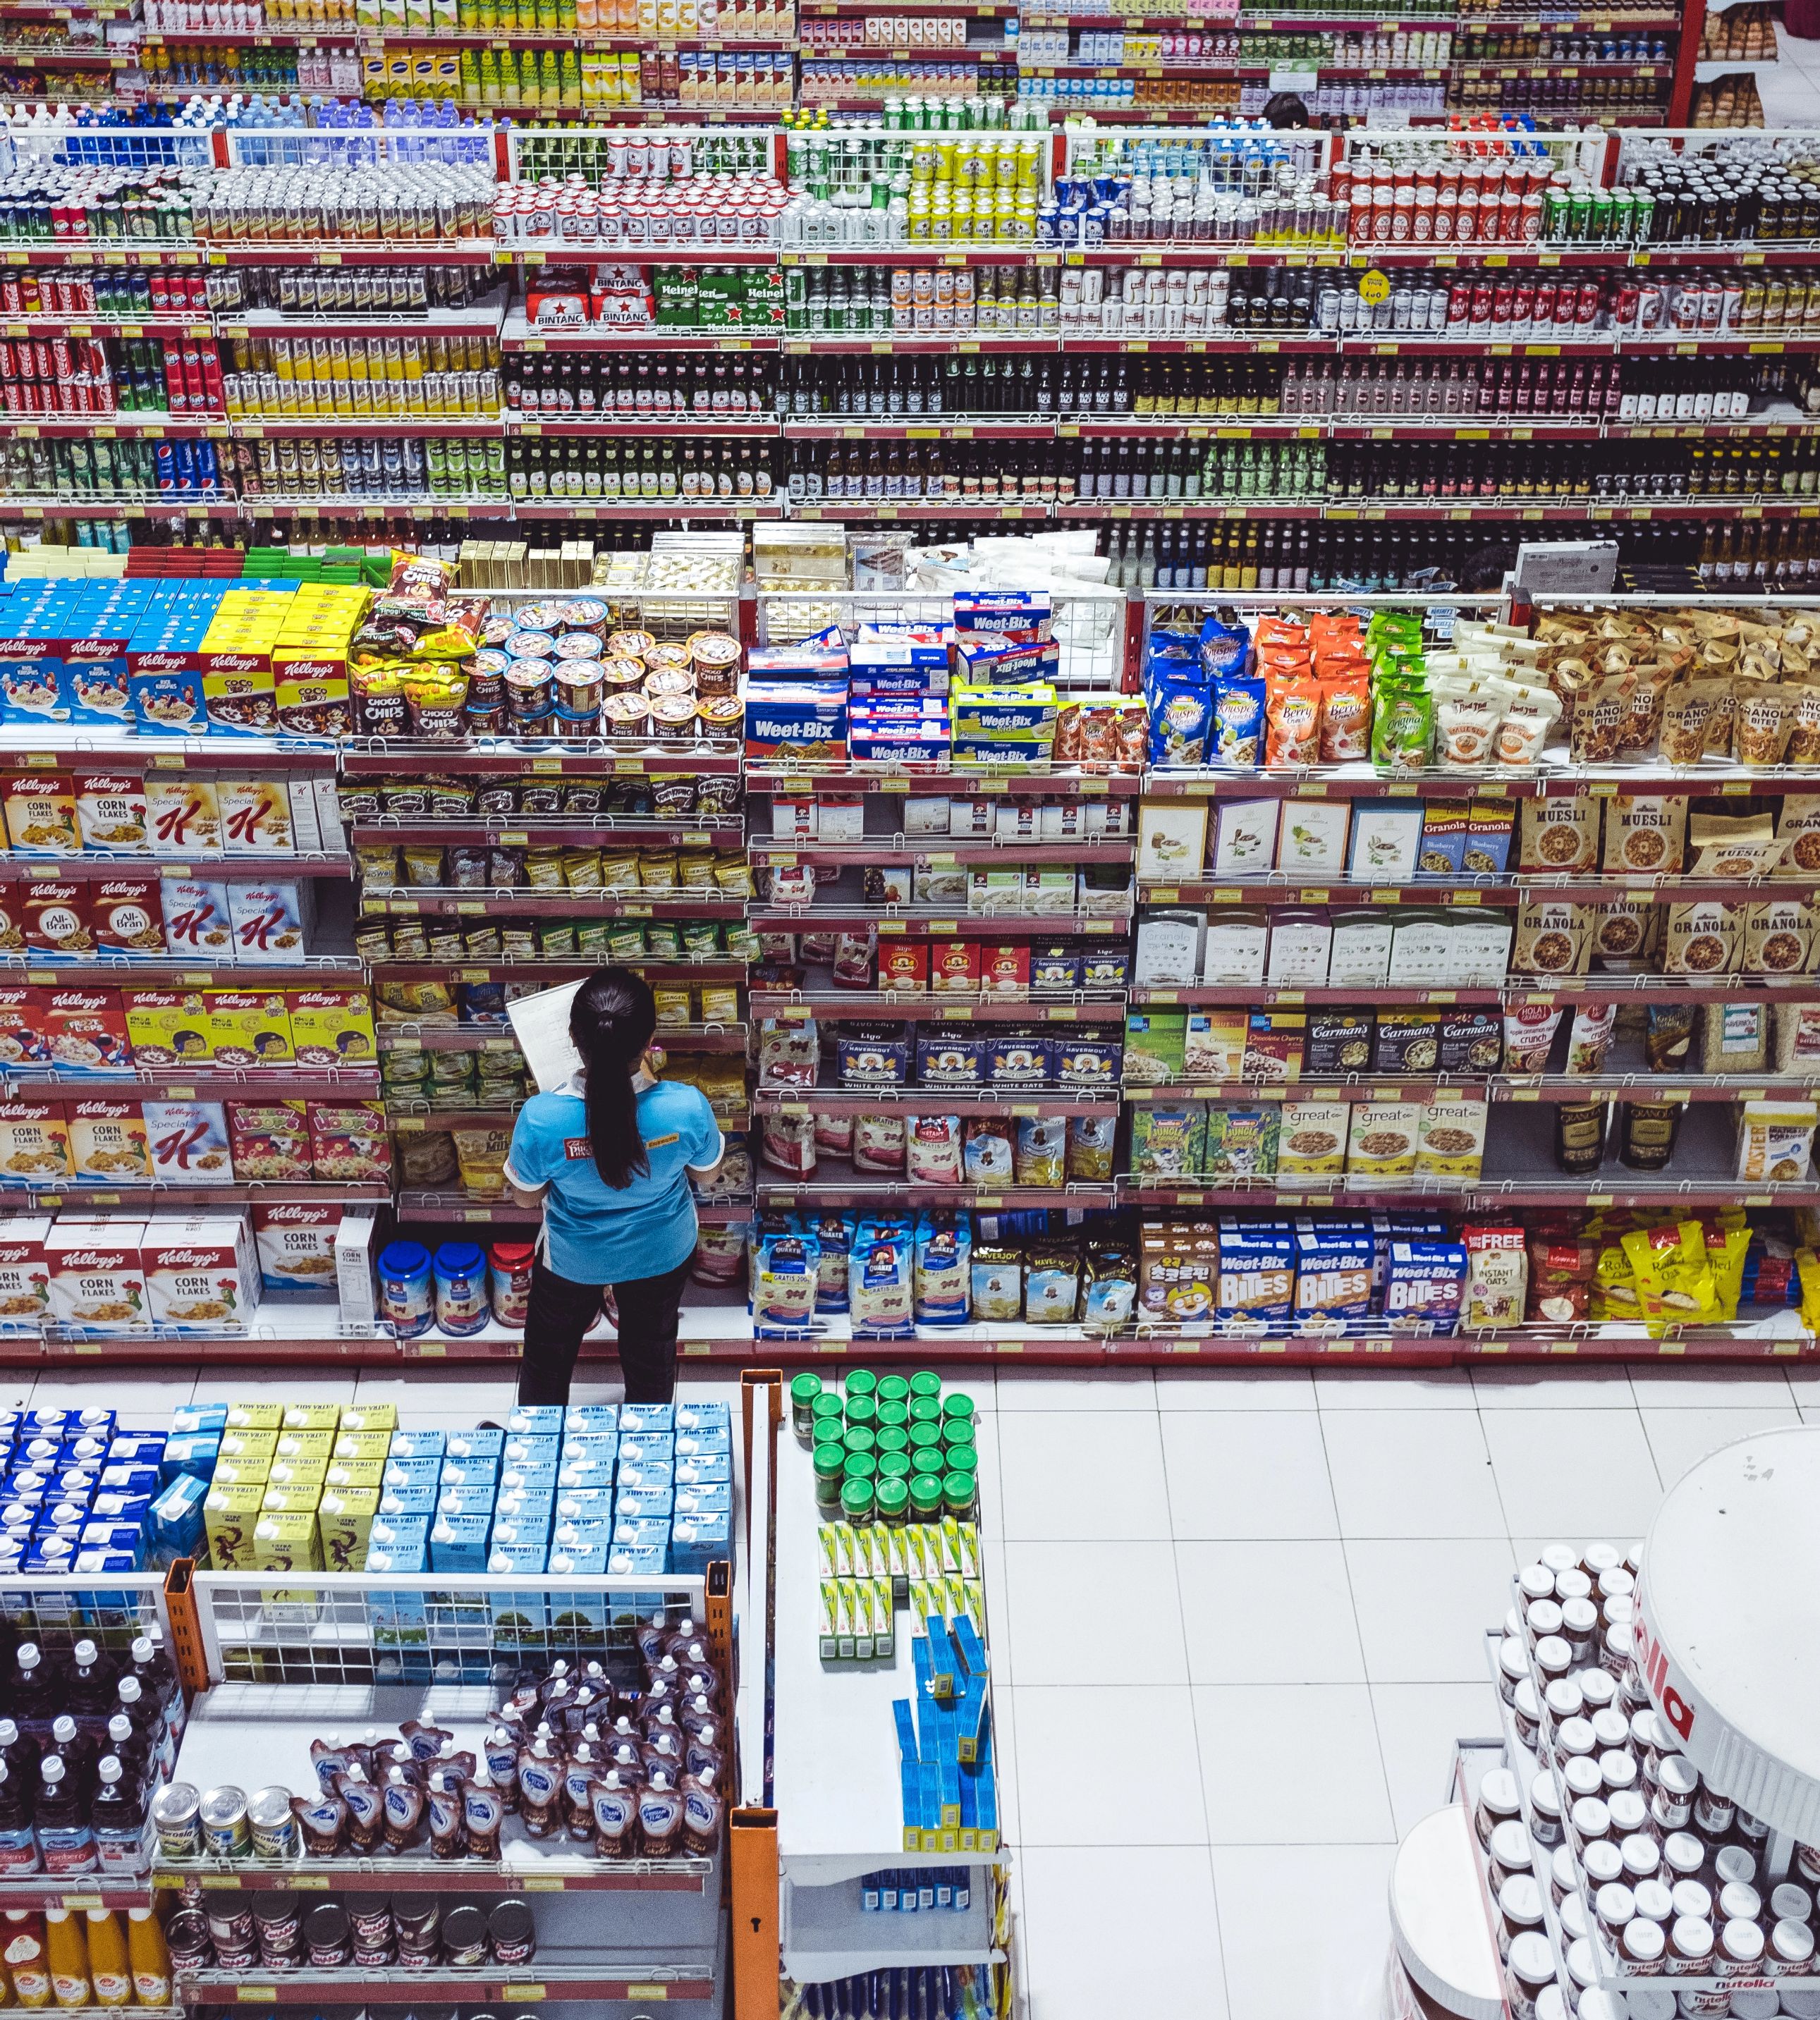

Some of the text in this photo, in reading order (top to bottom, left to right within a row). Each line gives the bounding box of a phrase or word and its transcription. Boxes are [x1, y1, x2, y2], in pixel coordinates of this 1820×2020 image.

[598, 279, 642, 288] BINTANG
[662, 285, 698, 295] Heine
[538, 315, 582, 324] BINTANG
[604, 312, 647, 321] BINTANG
[407, 565, 441, 575] CHOCO
[402, 571, 441, 587] CHIPS
[878, 625, 936, 634] Weet-Bix
[974, 617, 1032, 630] Weet-Bix
[71, 640, 118, 656] Kellogg's
[1203, 645, 1240, 657] Knusper
[138, 654, 186, 669] Kellogg's
[210, 654, 259, 670] Kellogg's
[285, 662, 334, 677] Kellogg's
[877, 680, 921, 690] Weet-Bix
[367, 697, 401, 706] CHOCO
[365, 707, 403, 720] CHIPS
[1166, 709, 1203, 720] Knusper
[1218, 704, 1257, 714] Knusper
[1283, 707, 1312, 719] Berry
[1331, 704, 1361, 716] Berry
[1740, 706, 1793, 718] GRANOLA
[420, 716, 458, 729] CHIPS
[982, 715, 1032, 726] Weet-Bix
[1388, 716, 1424, 730] Original
[1751, 717, 1777, 726] BITES
[755, 721, 834, 738] Weet-Bix
[872, 747, 931, 759] Weet-Bix
[977, 751, 1027, 761] Weet-Bix
[13, 779, 60, 793] Kellogg's
[84, 779, 131, 792] Kellogg's
[27, 802, 51, 812] CORN
[97, 800, 127, 812] CORN
[152, 797, 183, 807] Special
[223, 797, 254, 806] Special
[98, 810, 128, 819] FLAKES
[1537, 810, 1587, 822] MUESLI
[1622, 814, 1672, 826] MUESLI
[155, 800, 202, 845] K
[226, 800, 273, 845] K
[1424, 821, 1466, 833] Granola
[1469, 821, 1511, 832] Granola
[1785, 819, 1820, 829] GRAN
[1427, 841, 1455, 850] Blueberry
[1716, 849, 1768, 857] MUESLI
[30, 884, 76, 898] Kellogg's
[101, 883, 148, 896] Kellogg's
[169, 899, 198, 910] Special
[237, 905, 268, 915] Special
[47, 921, 72, 930] Bran
[117, 918, 142, 928] Bran
[171, 905, 214, 946] K
[1524, 918, 1585, 930] GRANOLA
[1674, 921, 1736, 933] GRANOLA
[1751, 918, 1813, 930] GRANOLA
[239, 909, 285, 950] K
[1145, 929, 1190, 942] Granola
[1312, 1024, 1369, 1039] Carman's
[1379, 1023, 1435, 1039] Carman's
[1443, 1022, 1498, 1038] Carman's
[861, 1032, 880, 1041] Ligo
[1520, 1034, 1546, 1043] crunch
[1290, 1109, 1331, 1125] great
[1362, 1110, 1403, 1127] great
[1427, 1106, 1469, 1121] great
[151, 1119, 189, 1129] Special
[12, 1128, 42, 1138] CORN
[92, 1126, 121, 1135] CORN
[94, 1134, 123, 1142] FLAKES
[154, 1122, 209, 1170] K
[267, 1206, 328, 1220] Kellogg's
[283, 1232, 317, 1244] CORN
[1482, 1235, 1523, 1249] FREE
[285, 1242, 318, 1251] FLAKES
[0, 1247, 29, 1261] ogg's
[62, 1251, 124, 1267] Kellogg's
[158, 1251, 220, 1266] Kellogg's
[1221, 1256, 1288, 1271] Weet-Bix
[1301, 1256, 1366, 1271] Weet-Bix
[1393, 1266, 1458, 1280] Weet-Bix
[0, 1281, 23, 1290] AKES
[80, 1278, 114, 1290] CORN
[175, 1277, 209, 1288] CORN
[82, 1287, 116, 1297] FLAKES
[176, 1286, 211, 1296] FLAKES
[1716, 1980, 1774, 1989] nutella
